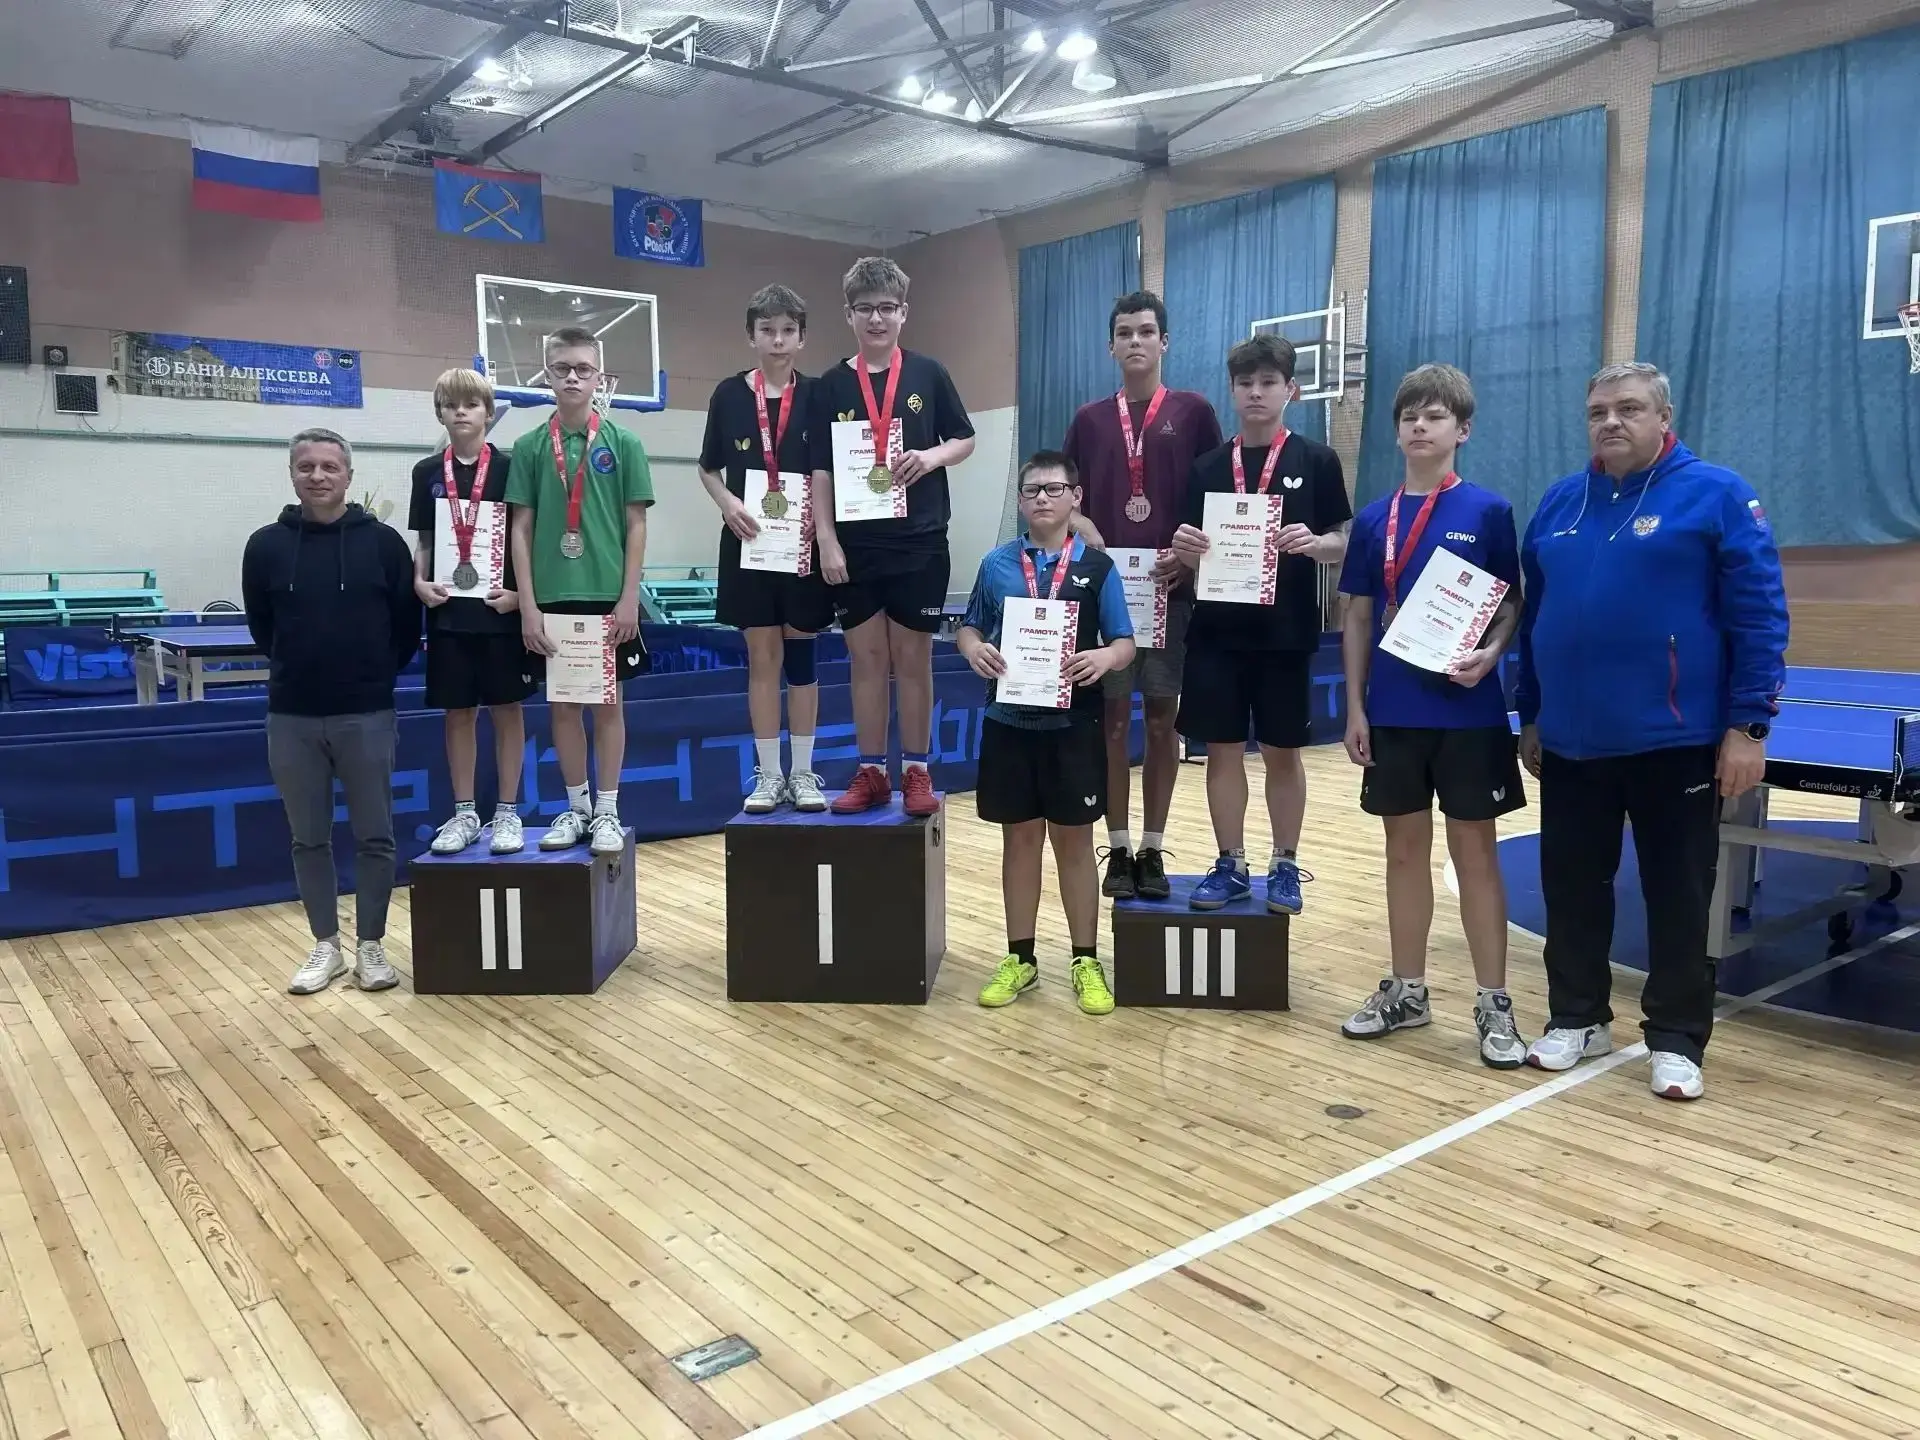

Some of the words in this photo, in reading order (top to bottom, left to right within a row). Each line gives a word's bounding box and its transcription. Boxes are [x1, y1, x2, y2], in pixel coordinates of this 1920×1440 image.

[174, 362, 225, 378] БАНИ
[230, 367, 331, 385] АЛЕКСЕЕВА
[1220, 523, 1261, 531] ГРАМОТА
[1445, 531, 1476, 543] GEWO
[1435, 583, 1475, 609] ГРАМОТА
[1019, 627, 1059, 636] ГРАМОТА
[1799, 779, 1847, 793] Centrefold
[1849, 784, 1861, 794] 25
[480, 888, 523, 969] II
[1165, 926, 1236, 997] III
